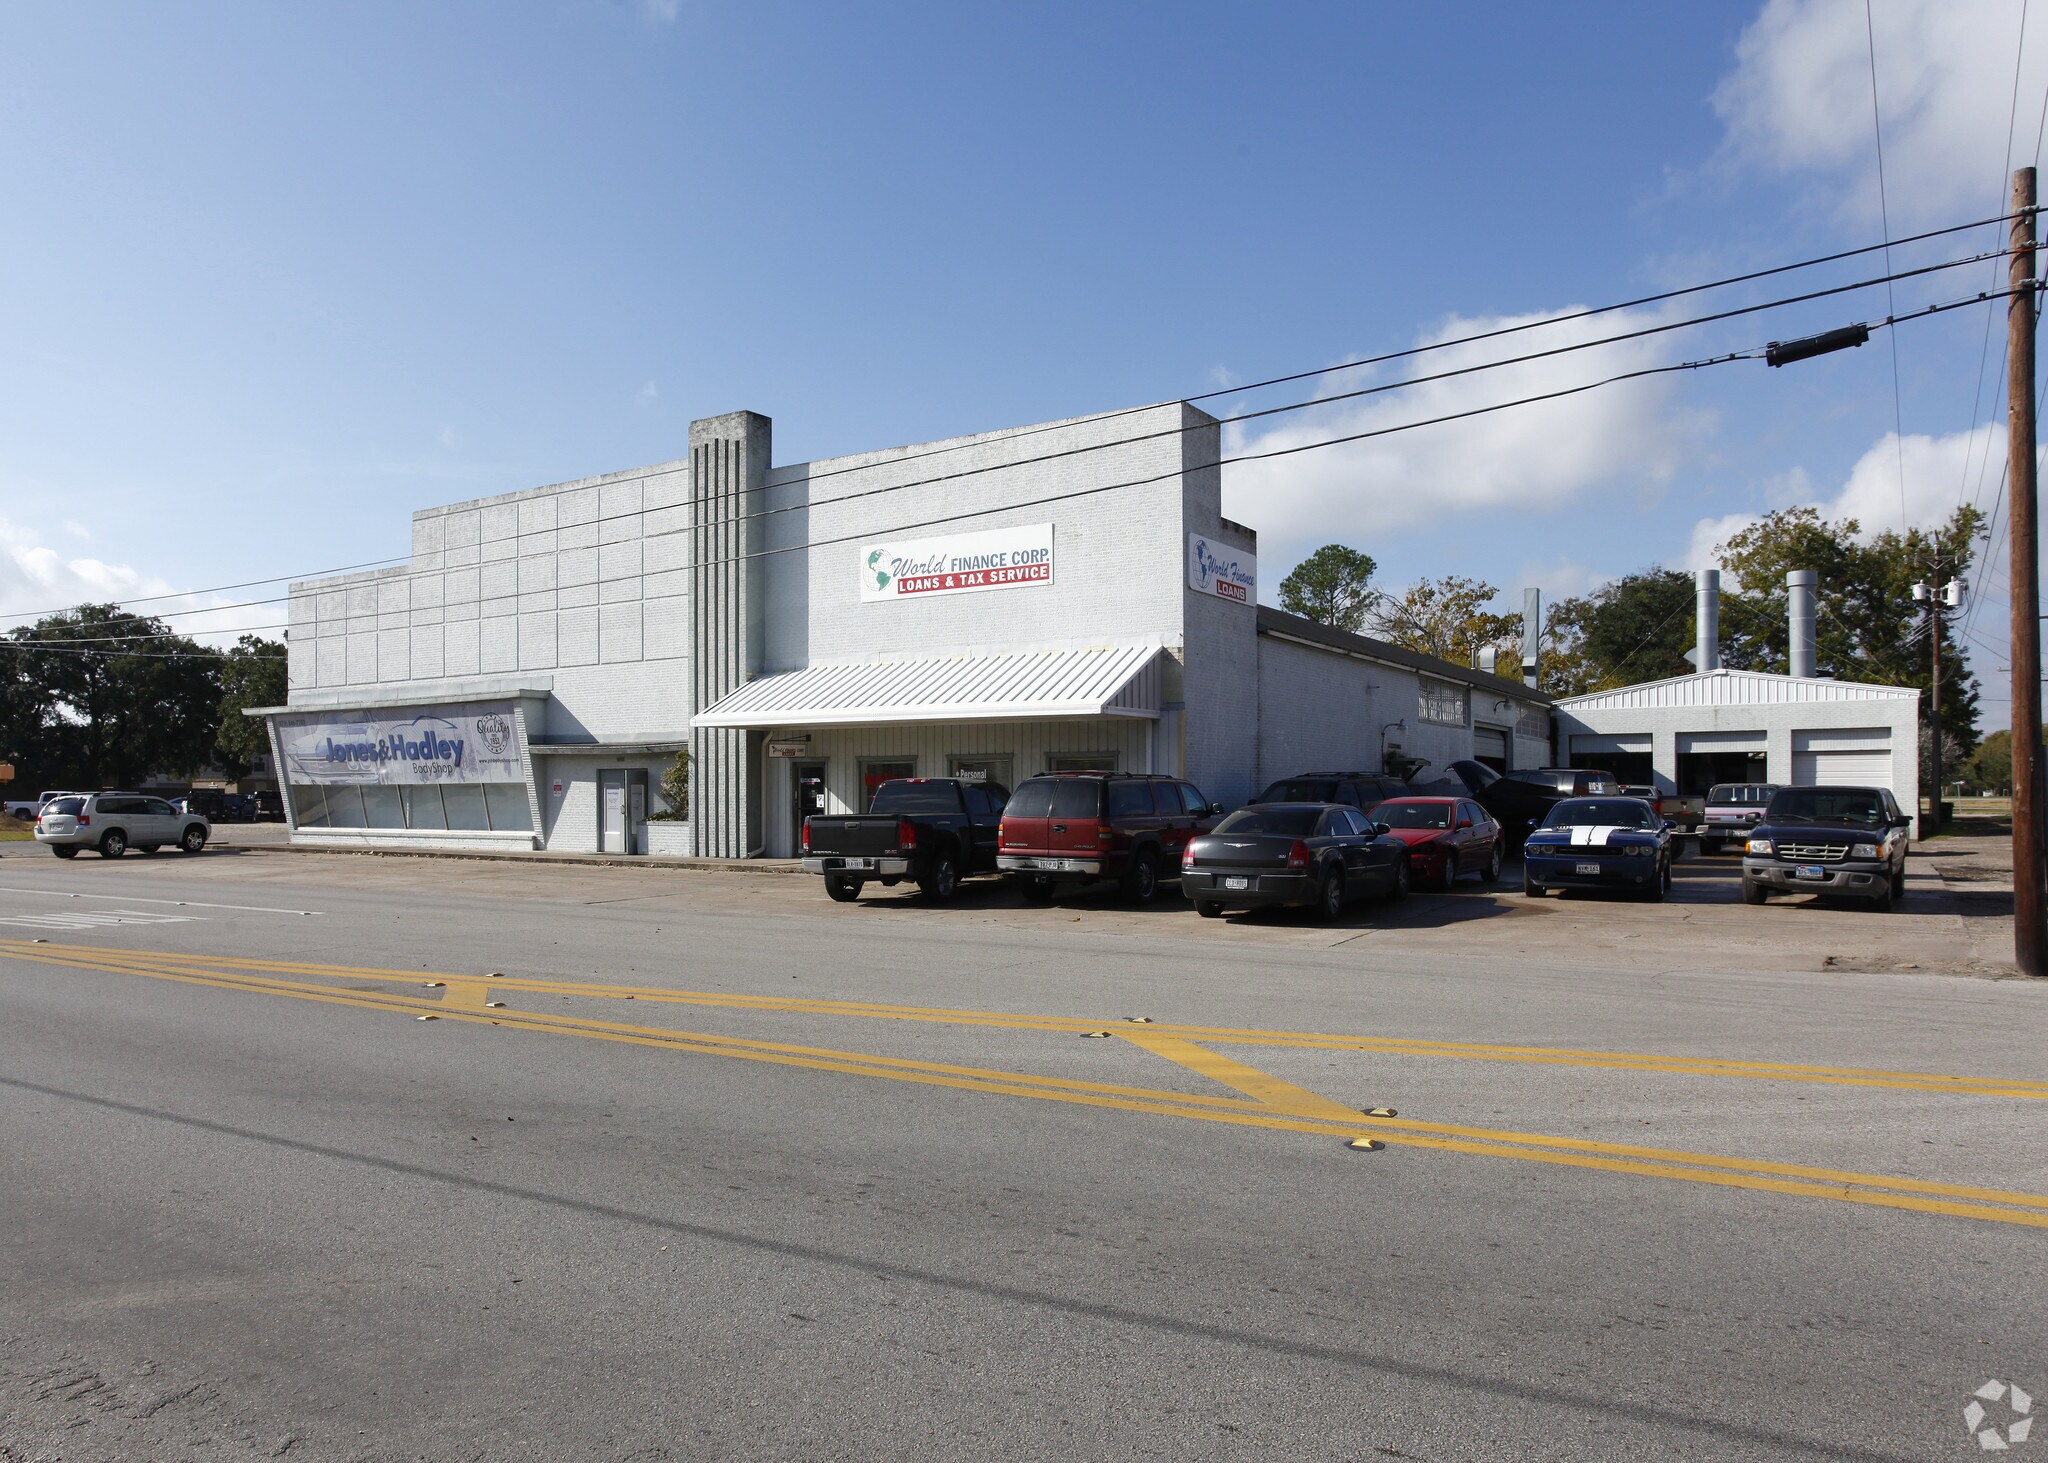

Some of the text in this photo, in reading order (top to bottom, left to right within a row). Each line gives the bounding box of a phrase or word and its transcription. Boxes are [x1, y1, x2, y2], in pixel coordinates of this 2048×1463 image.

[890, 547, 1050, 578] World FINANCE CORP.
[898, 565, 1049, 592] LOANS & TAX SERVICE
[1217, 582, 1246, 600] LOANS
[960, 768, 987, 779] Personal
